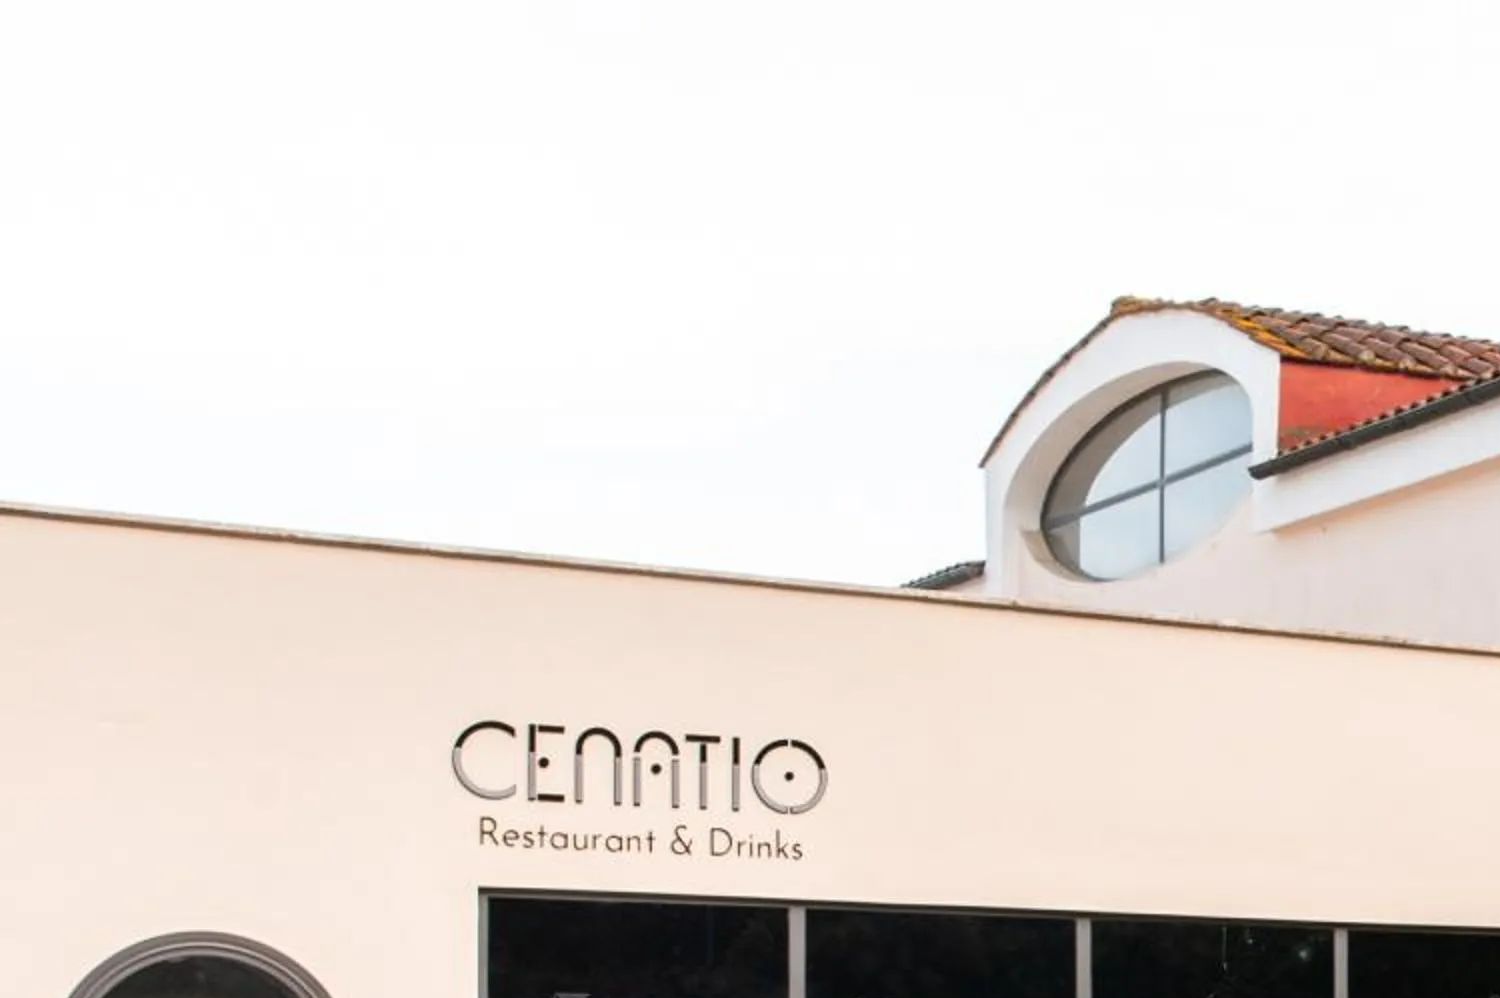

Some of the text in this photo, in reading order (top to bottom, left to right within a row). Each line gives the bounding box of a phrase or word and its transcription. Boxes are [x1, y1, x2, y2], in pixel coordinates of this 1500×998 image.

[451, 719, 829, 815] CENATIO
[479, 816, 804, 861] Restaurant & Drinks
